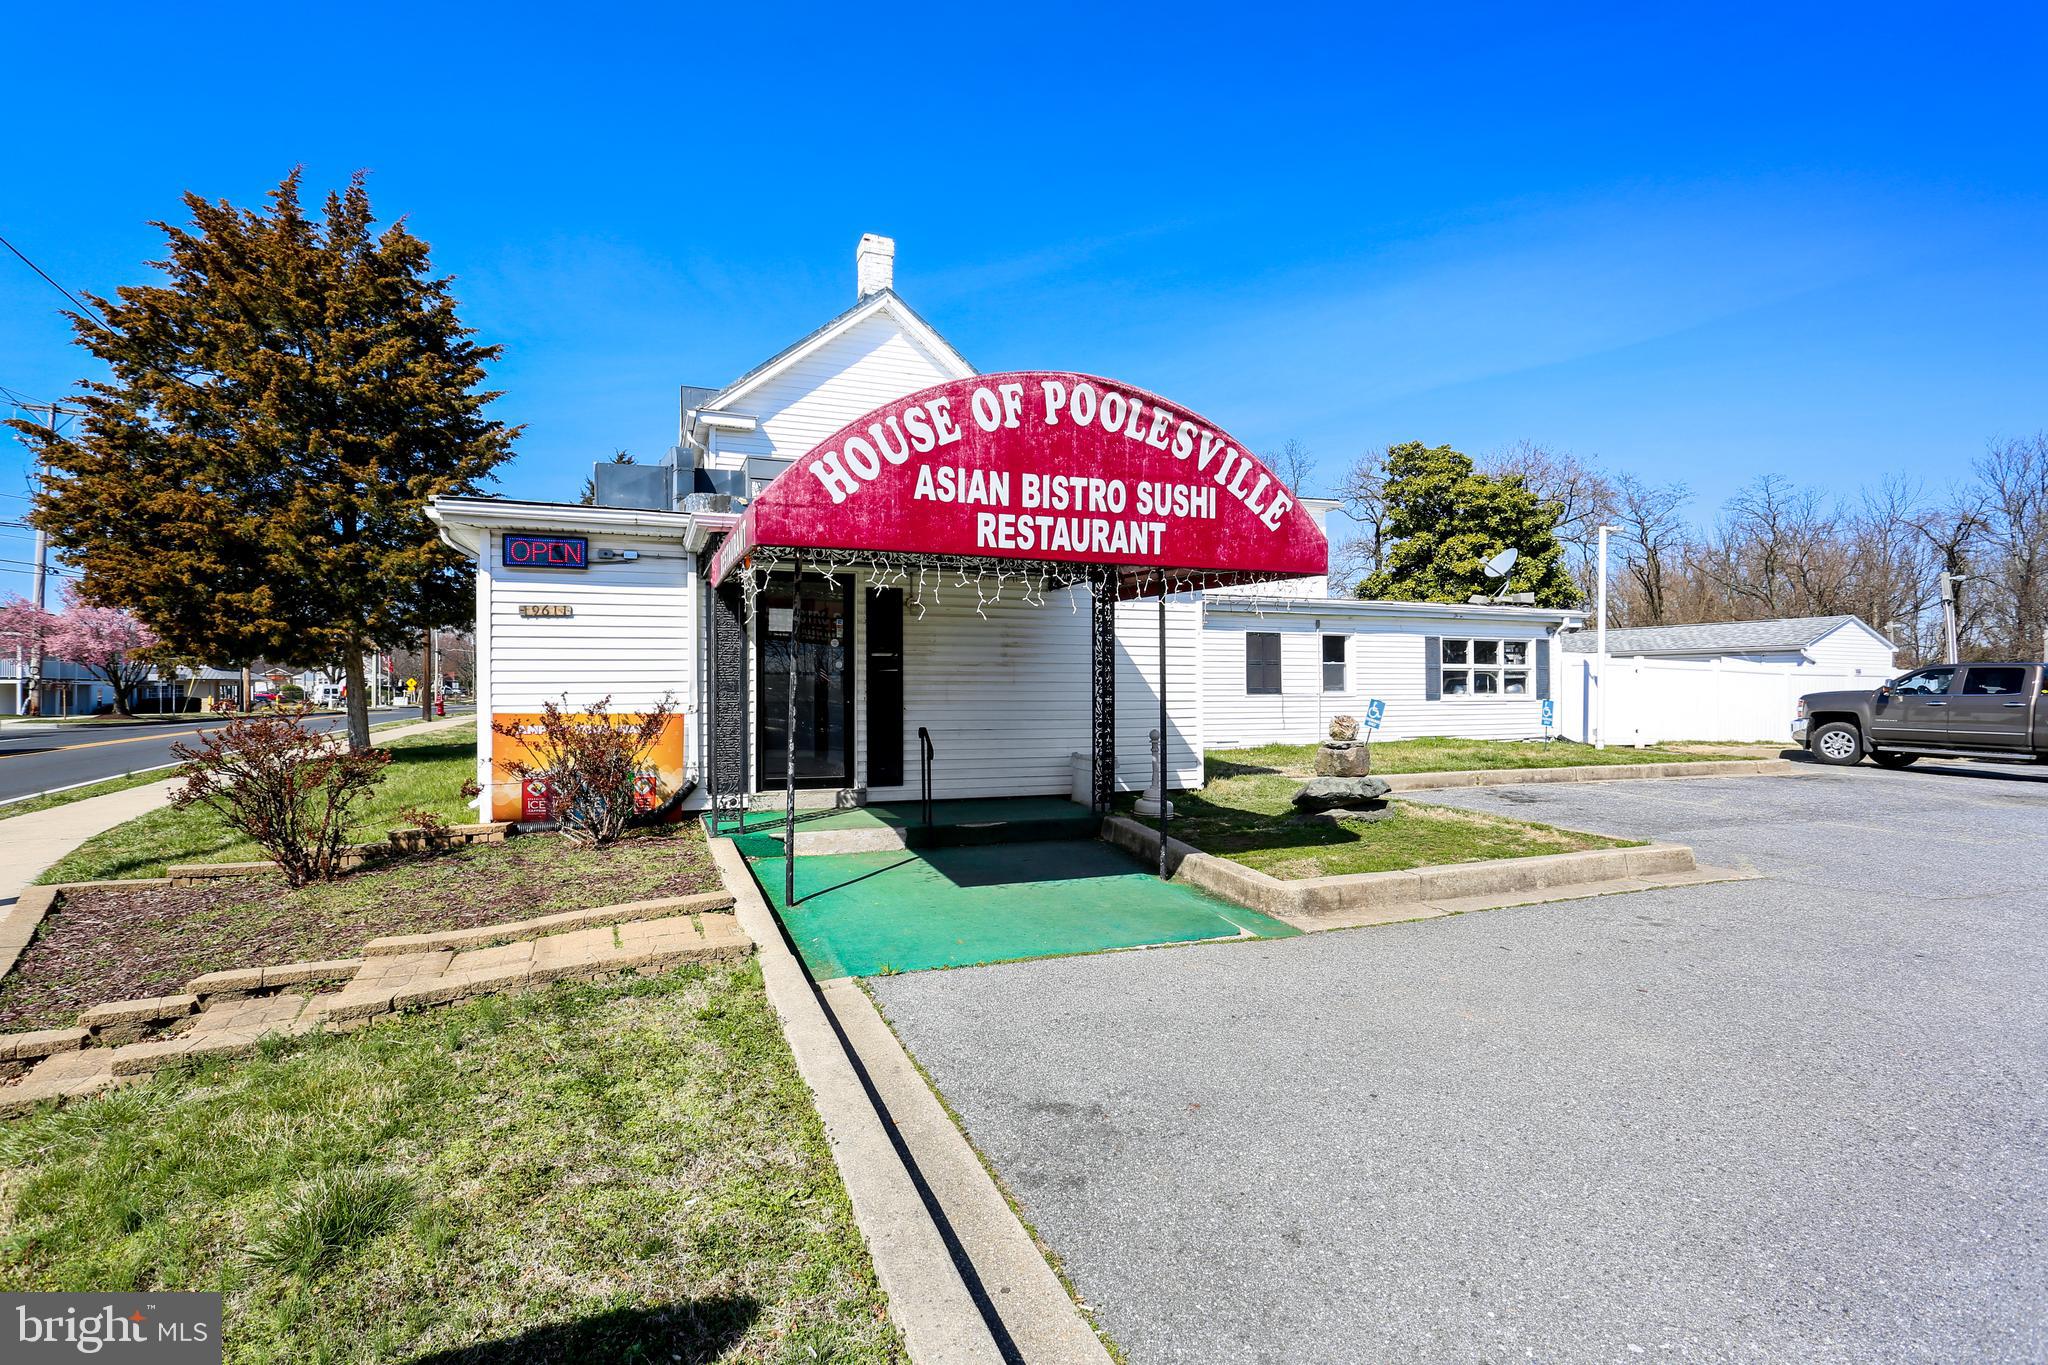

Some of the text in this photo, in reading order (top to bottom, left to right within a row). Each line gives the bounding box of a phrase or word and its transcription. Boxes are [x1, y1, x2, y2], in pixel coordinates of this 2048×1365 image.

[808, 381, 1293, 532] HOUSE OF POOLESVILLE
[914, 465, 1216, 519] ASIAN BISTRO SUSHI
[511, 540, 581, 563] OPEN
[977, 513, 1167, 555] RESTAURANT
[527, 800, 546, 809] ICE
